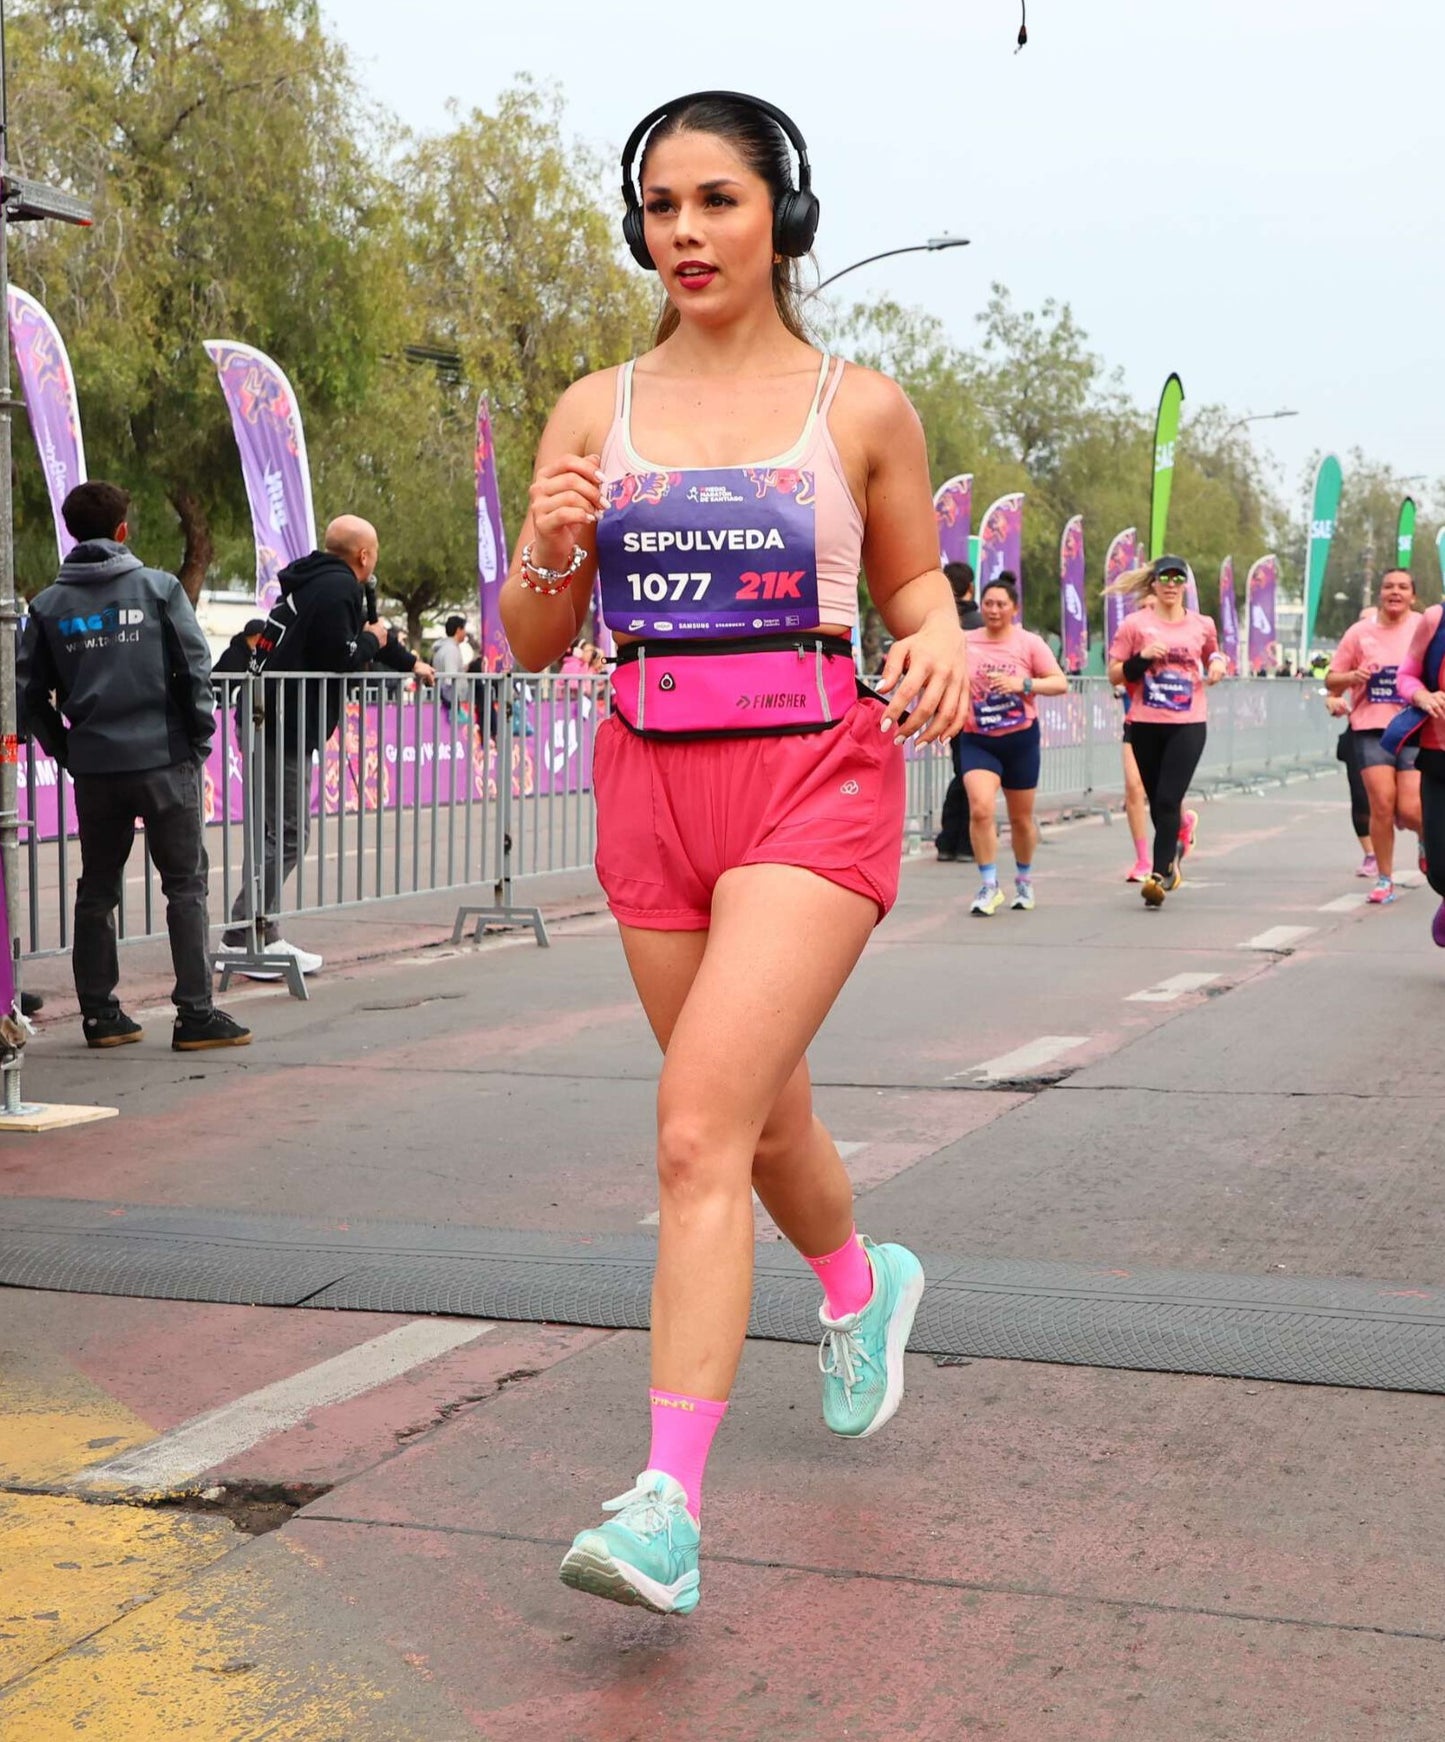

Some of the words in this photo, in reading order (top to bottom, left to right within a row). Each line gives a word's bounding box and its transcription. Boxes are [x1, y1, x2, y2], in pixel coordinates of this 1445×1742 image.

[624, 529, 785, 552] SEPULVEDA
[627, 572, 712, 602] 1077
[736, 571, 806, 599] 21K
[118, 608, 145, 625] ID
[753, 693, 807, 709] FINISHER
